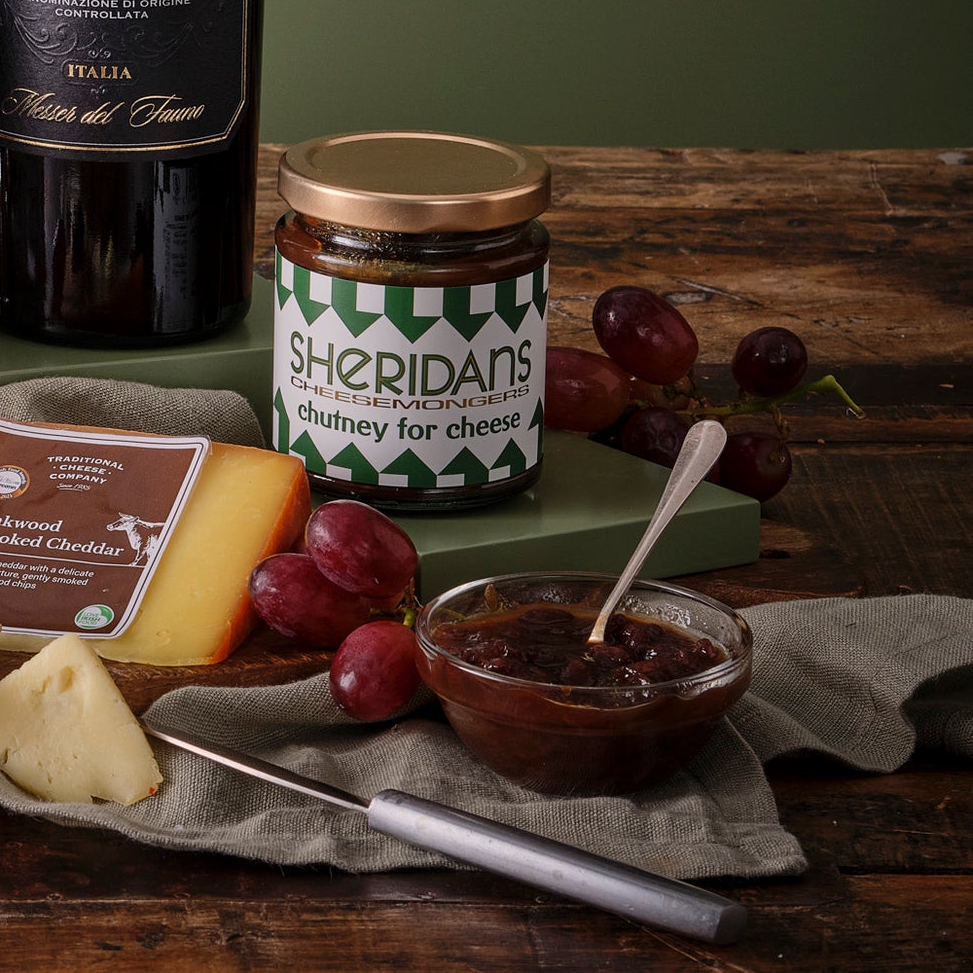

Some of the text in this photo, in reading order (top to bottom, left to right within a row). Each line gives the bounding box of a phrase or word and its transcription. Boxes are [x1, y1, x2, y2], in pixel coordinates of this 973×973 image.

[123, 0, 137, 8] DI
[55, 8, 149, 19] CONTROLLATA
[67, 64, 132, 79] ITALIA
[1, 88, 206, 128] Messer del Fauno
[290, 375, 530, 410] CHEESEMONGERS
[297, 400, 521, 443] chutney for cheese
[47, 456, 124, 471] TRADITIONAL
[59, 464, 107, 475] CHEESE
[49, 473, 107, 484] COMPANY
[46, 537, 124, 557] Cheddar
[29, 564, 48, 572] with
[58, 567, 95, 577] delicate
[11, 579, 37, 590] chips
[22, 572, 50, 583] gently
[52, 576, 88, 586] smoked
